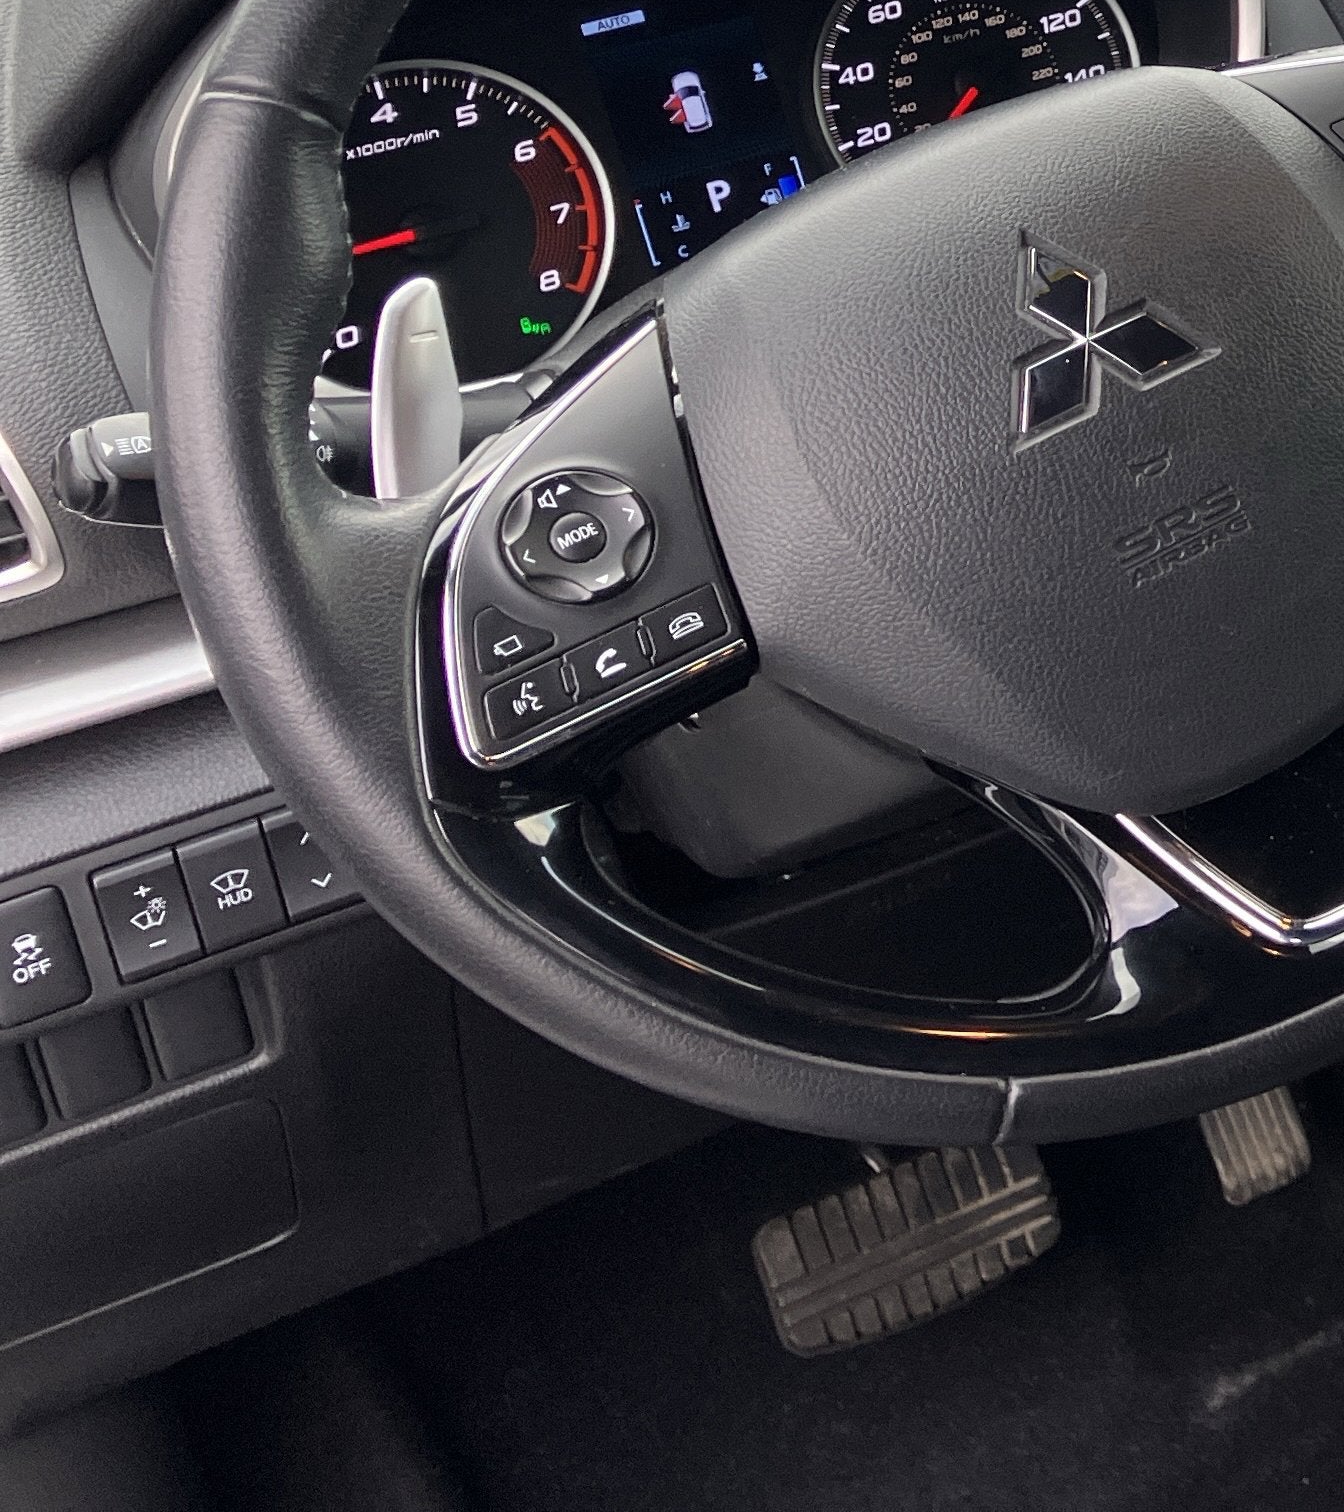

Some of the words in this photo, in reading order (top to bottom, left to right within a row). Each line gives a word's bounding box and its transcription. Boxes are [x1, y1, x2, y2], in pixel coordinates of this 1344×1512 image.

[597, 14, 631, 31] AUTO
[867, 0, 902, 24] 60
[931, 16, 953, 29] 120
[957, 9, 979, 23] 140
[984, 14, 1006, 27] 160
[1039, 8, 1082, 34] 120
[911, 30, 933, 43] 100
[943, 28, 980, 44] km/h
[1005, 26, 1026, 39] 180
[900, 51, 918, 65] 80
[1021, 44, 1043, 58] 200
[838, 62, 875, 85] 40
[894, 75, 913, 88] 60
[1031, 67, 1053, 81] 220
[370, 102, 399, 124] 4
[455, 104, 479, 128] 5
[899, 102, 917, 114] 40
[346, 128, 440, 161] x1000r/min
[857, 121, 892, 148] 20
[514, 139, 537, 163] 6
[763, 162, 773, 176] F
[660, 190, 673, 204] H
[706, 179, 731, 213] P
[549, 202, 571, 225] 7
[678, 244, 689, 258] C
[539, 269, 561, 292] 8
[335, 325, 359, 350] 0
[557, 522, 599, 550] MODE
[1116, 486, 1241, 569] SRS
[217, 888, 253, 910] HUD
[12, 957, 52, 984] OFF
